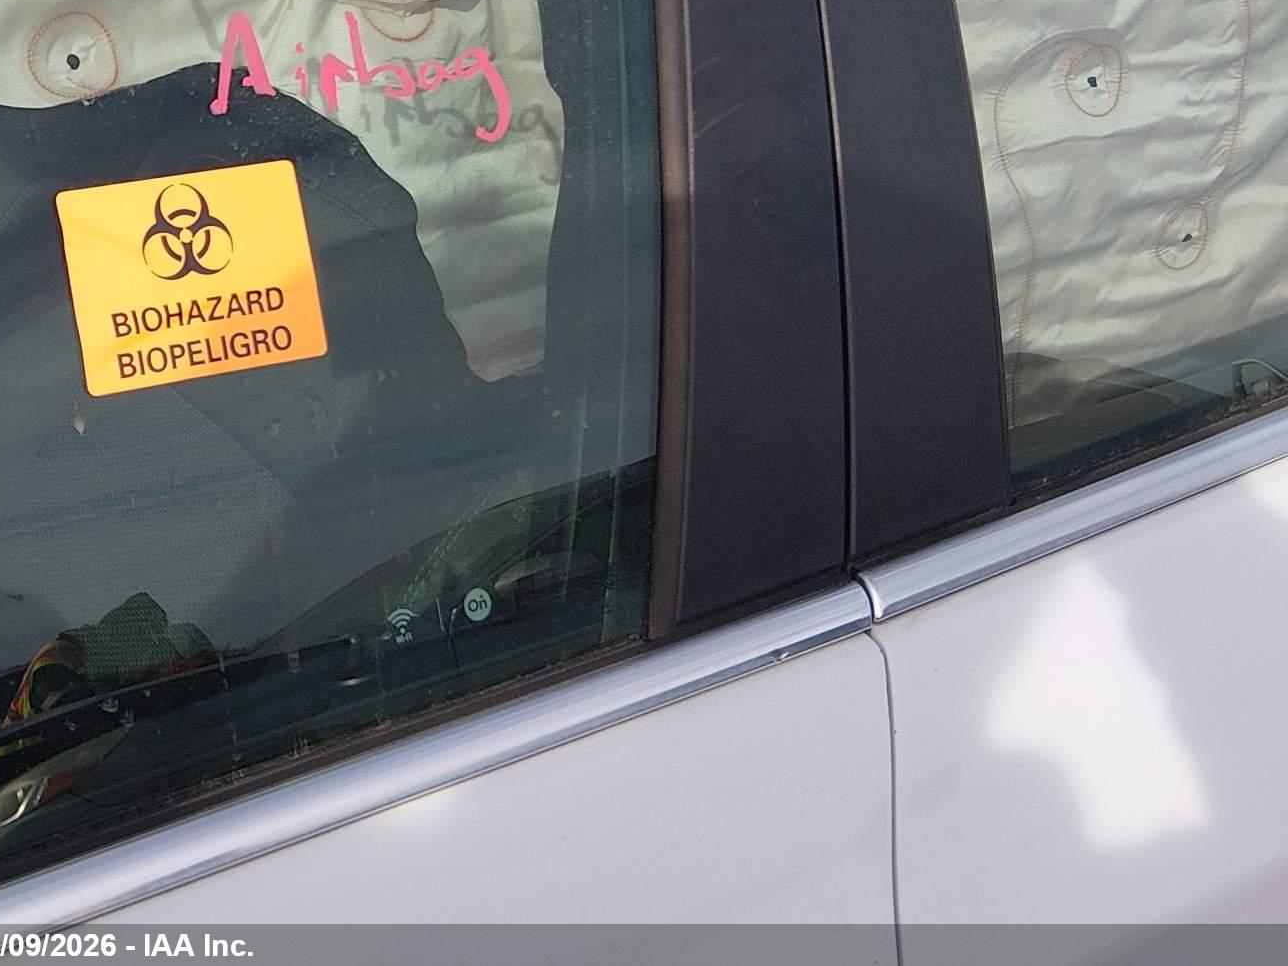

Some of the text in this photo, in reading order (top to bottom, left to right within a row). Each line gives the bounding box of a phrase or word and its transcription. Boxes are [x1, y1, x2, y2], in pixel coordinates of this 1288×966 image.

[209, 11, 512, 144] Airbag
[111, 286, 285, 339] BIOHAZARD
[117, 324, 293, 380] BIOPELIGRO
